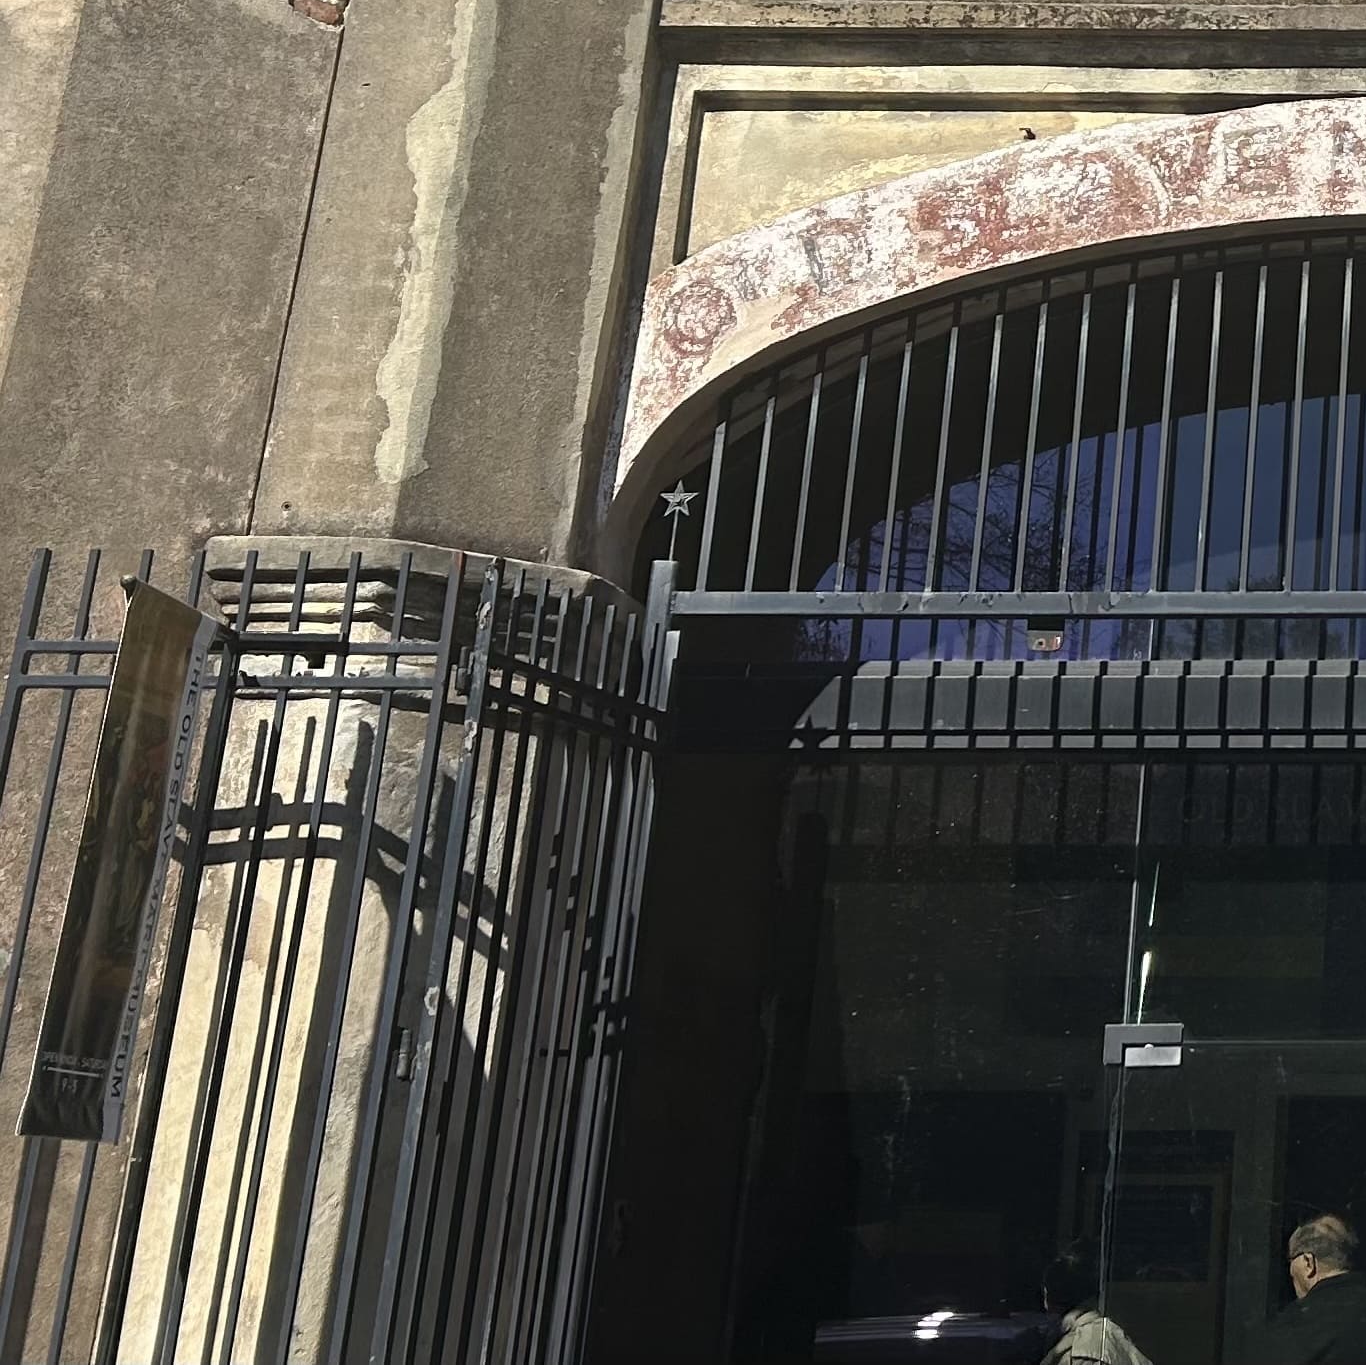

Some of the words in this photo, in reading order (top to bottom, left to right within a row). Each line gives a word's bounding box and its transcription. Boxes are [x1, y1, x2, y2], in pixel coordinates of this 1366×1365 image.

[186, 654, 204, 707] THE
[174, 715, 192, 771] OLD
[111, 969, 143, 1098] MUSEUM
